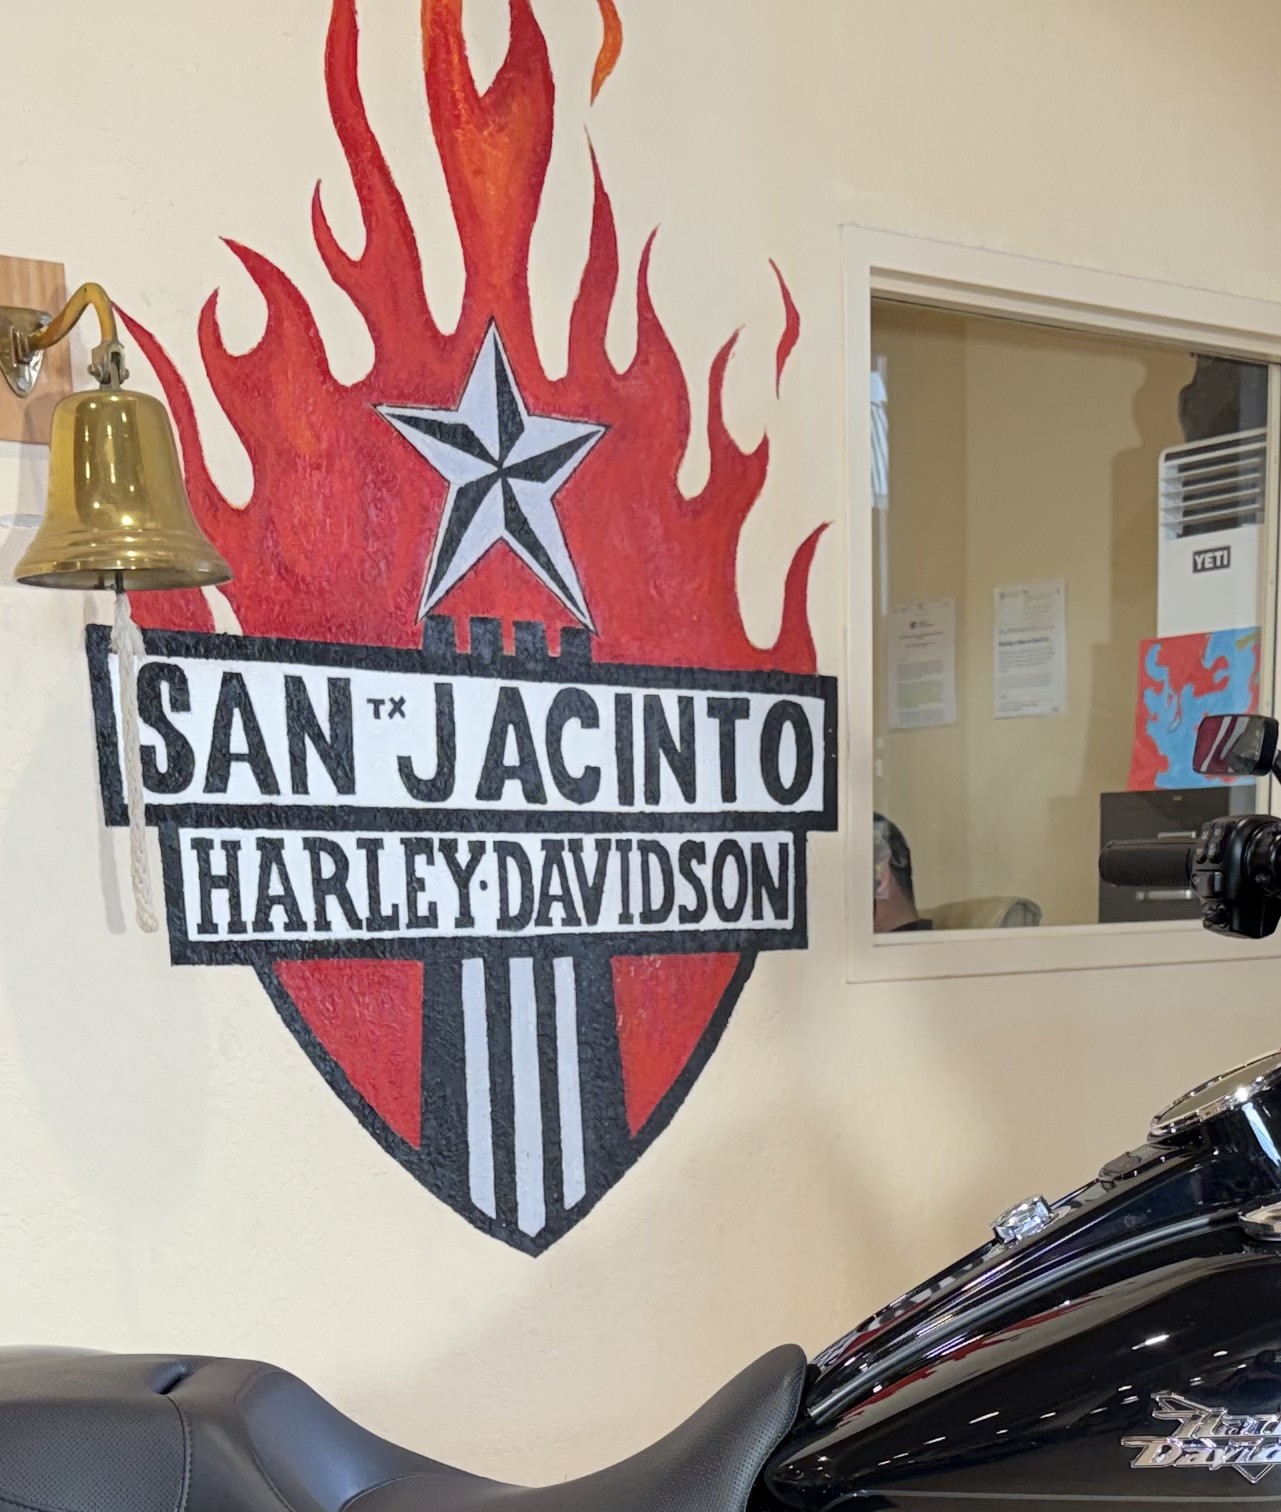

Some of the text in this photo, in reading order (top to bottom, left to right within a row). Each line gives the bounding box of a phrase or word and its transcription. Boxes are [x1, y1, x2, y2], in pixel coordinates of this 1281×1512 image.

[1194, 549, 1229, 570] YETI
[366, 696, 407, 720] TX
[136, 661, 814, 806] SAN JACINTO
